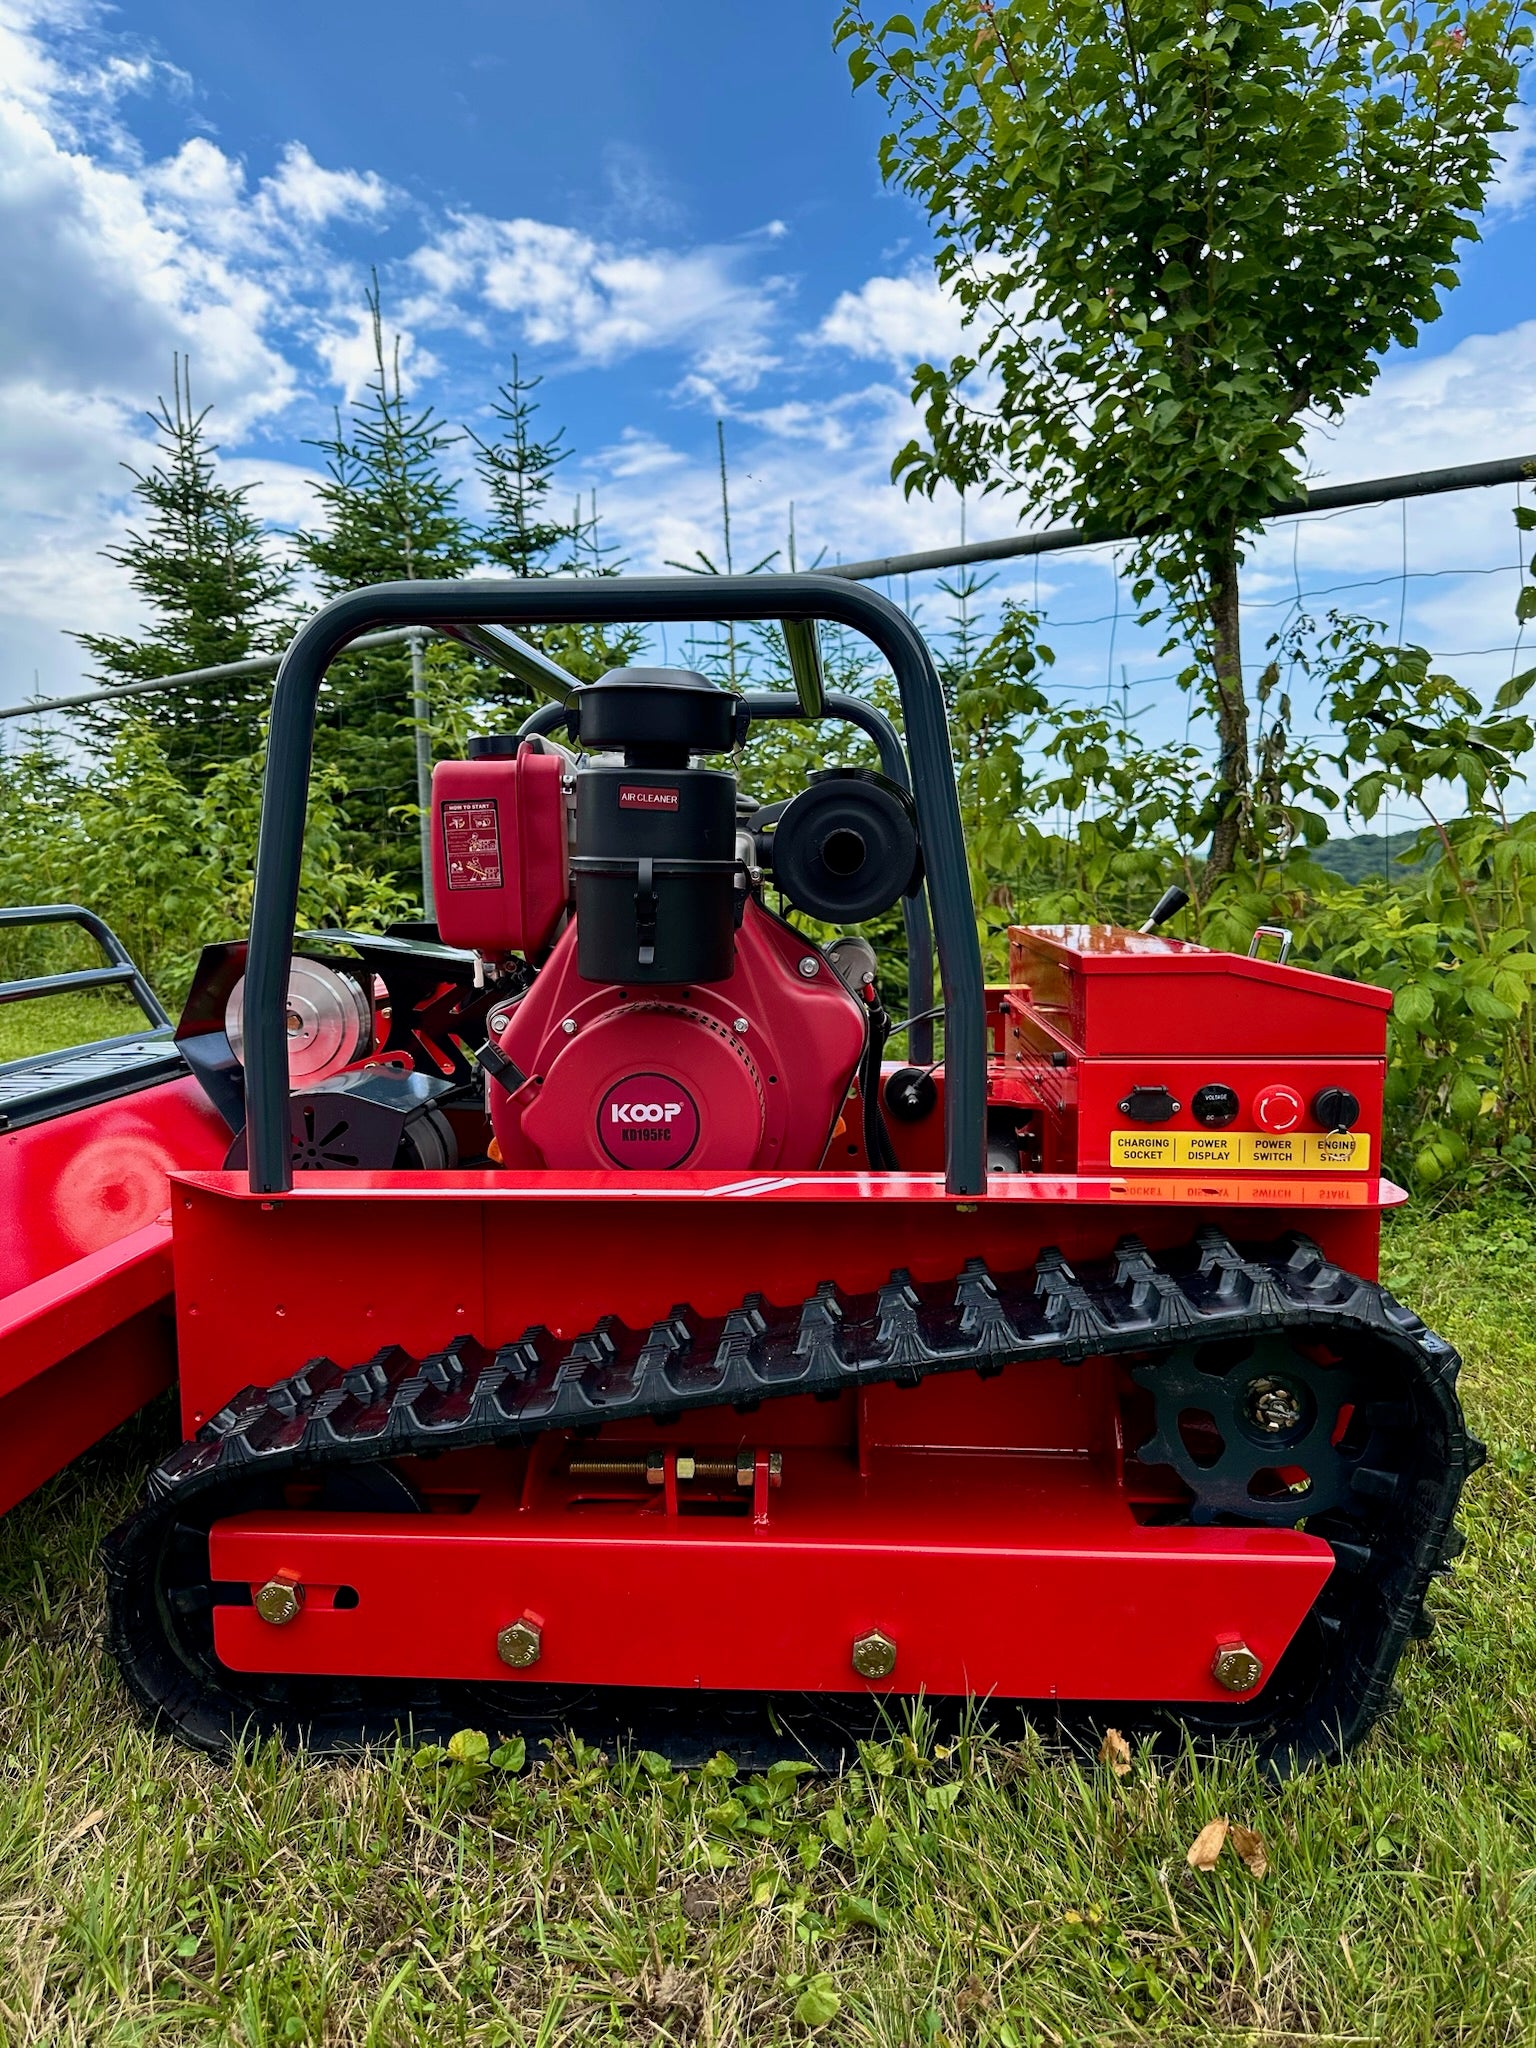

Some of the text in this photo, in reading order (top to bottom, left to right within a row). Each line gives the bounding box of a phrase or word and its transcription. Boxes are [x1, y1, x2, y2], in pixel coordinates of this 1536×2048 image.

[621, 793, 678, 804] AIR CLEANER
[611, 1103, 681, 1123] KOOP
[622, 1128, 671, 1141] KD195FC
[1117, 1138, 1170, 1148] CHARGING
[1191, 1139, 1227, 1148] POWER
[1255, 1140, 1292, 1149] POWER
[1317, 1140, 1356, 1150] ENGINE
[1123, 1150, 1163, 1160] SOCKET
[1188, 1151, 1230, 1160] DISPLAY
[1253, 1152, 1293, 1161] SWITCH
